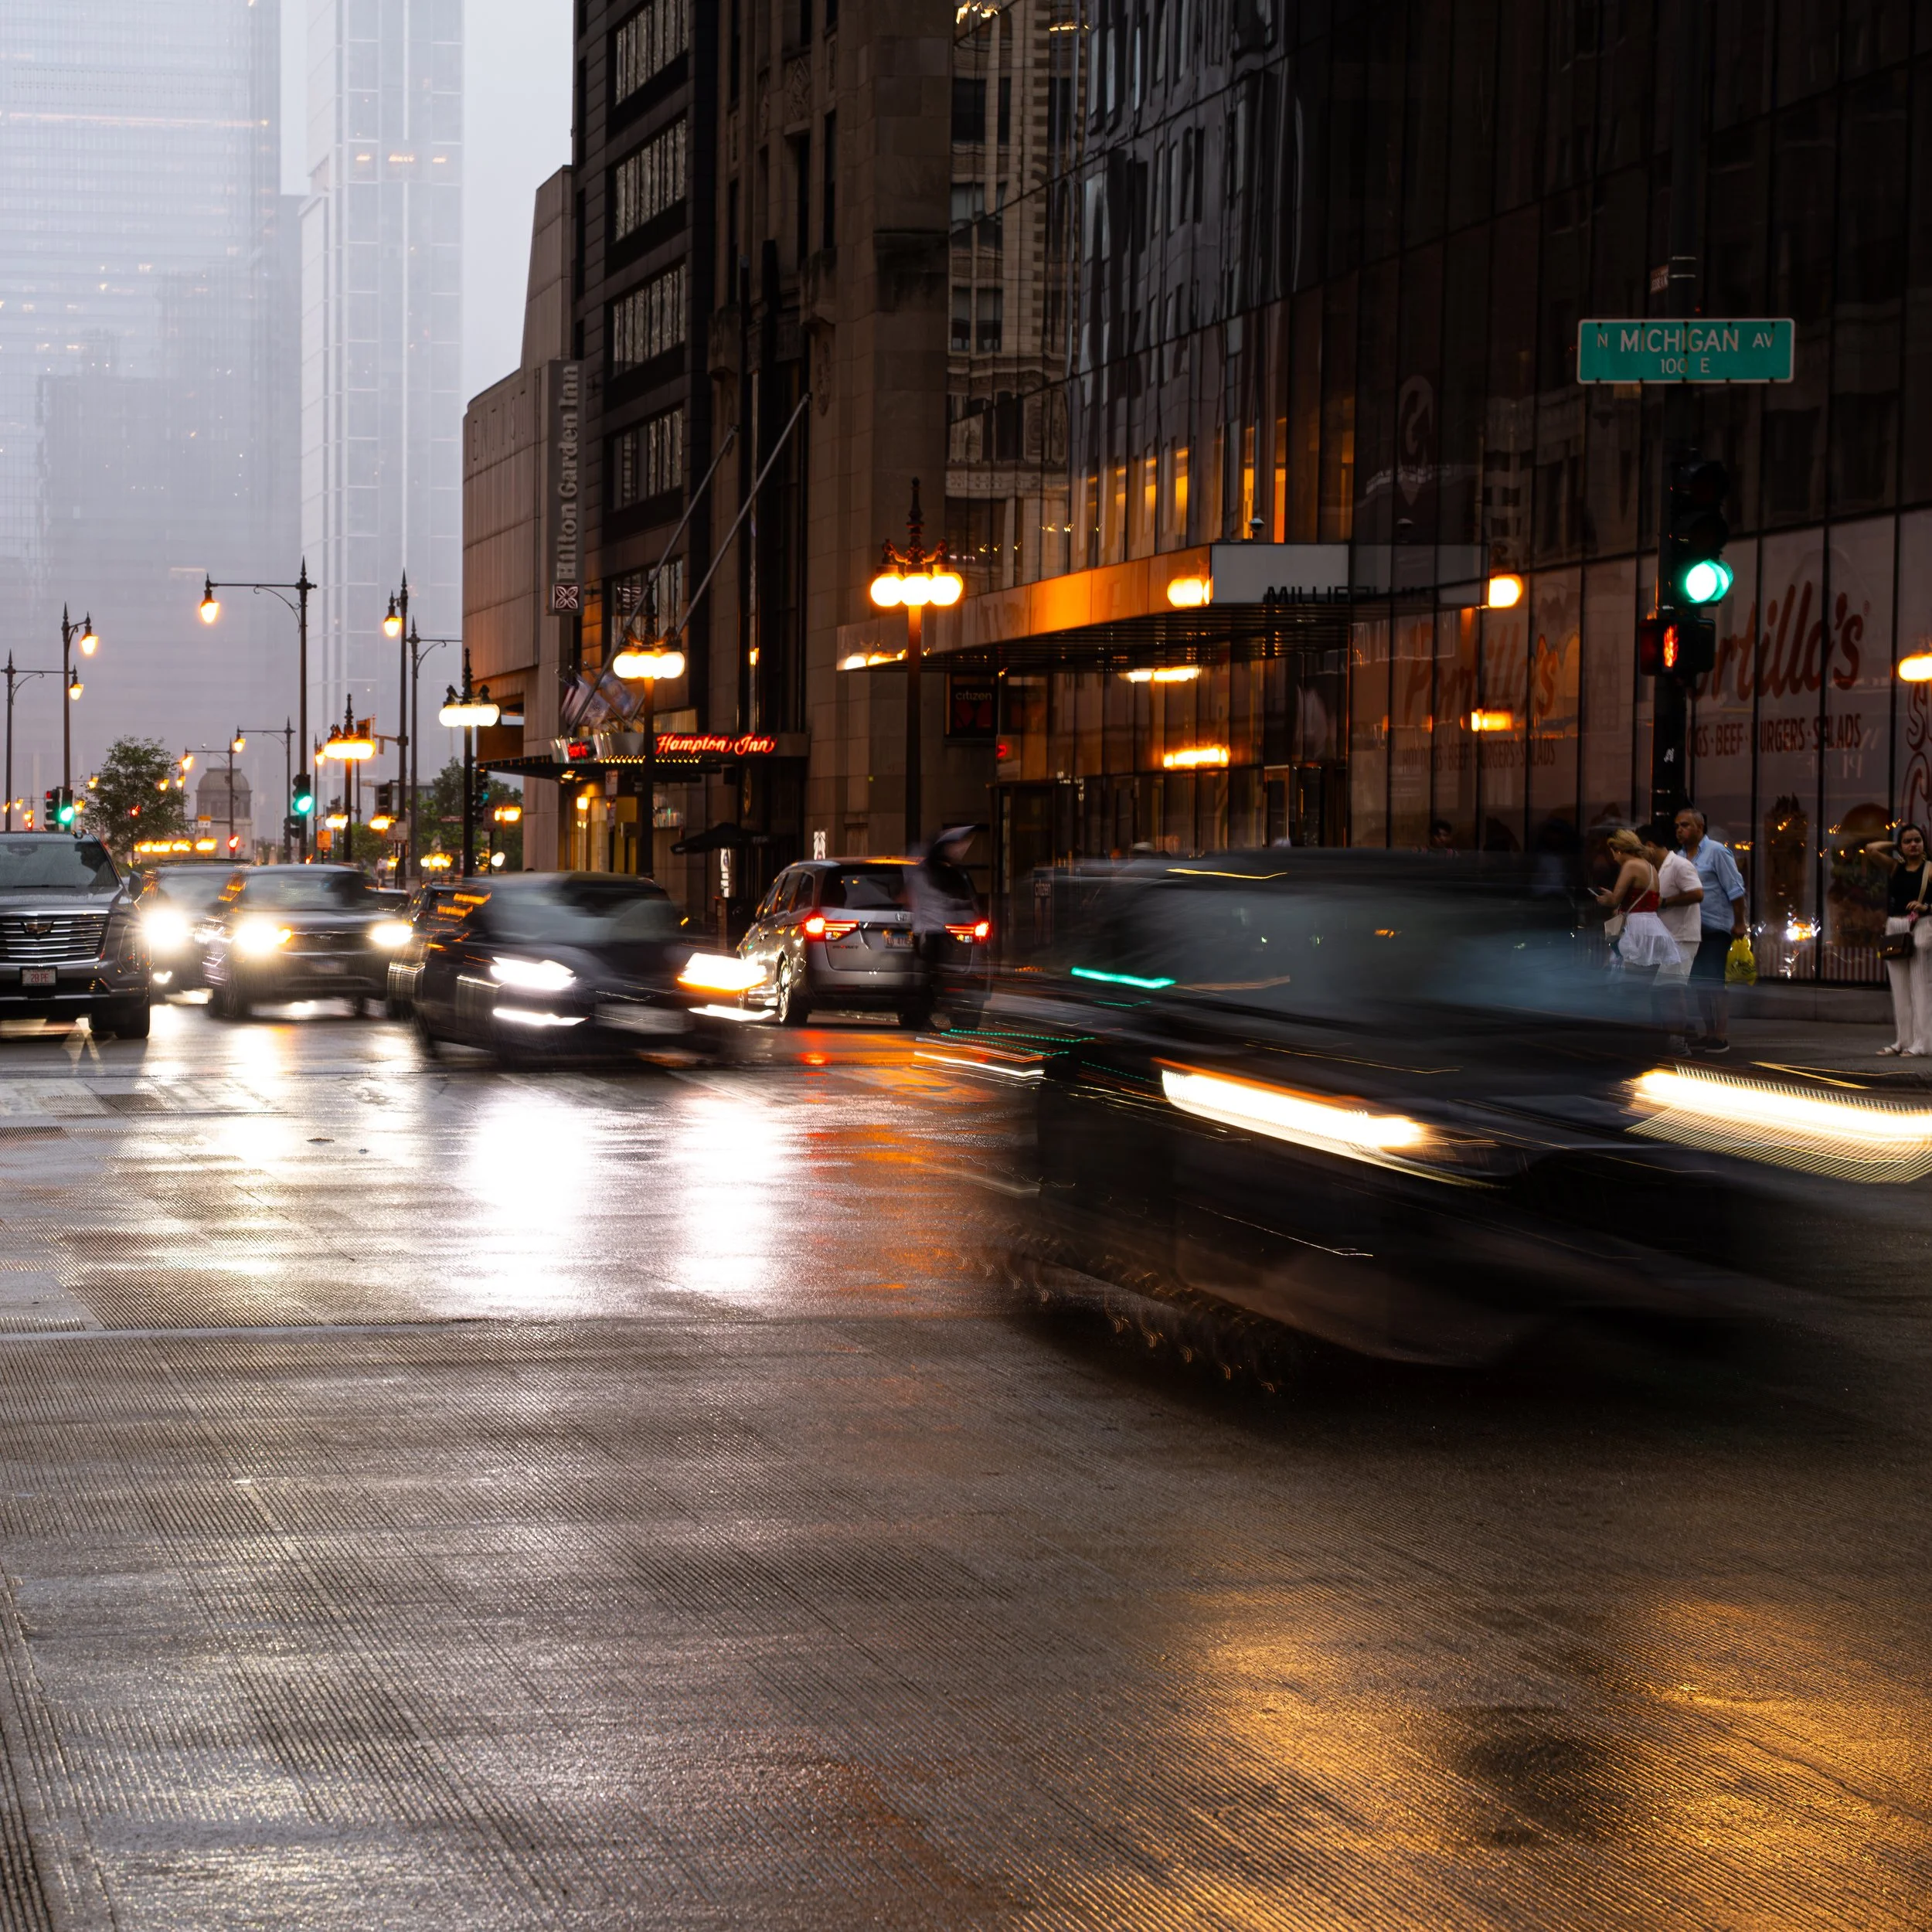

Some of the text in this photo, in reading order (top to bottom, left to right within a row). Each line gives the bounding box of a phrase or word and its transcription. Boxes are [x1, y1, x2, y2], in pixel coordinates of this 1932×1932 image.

[1596, 328, 1775, 353] N MICHIGAN AV
[1661, 358, 1711, 375] 100 E
[556, 365, 578, 581] Hilton Garden Inn
[1686, 581, 1864, 702] rtillo's
[954, 689, 993, 702] citizen
[655, 732, 777, 755] Hampton Inn
[1476, 738, 1515, 769] URGERS
[1517, 736, 1556, 766] SLADS
[1685, 723, 1709, 757] OGS
[1716, 722, 1744, 757] BEEF
